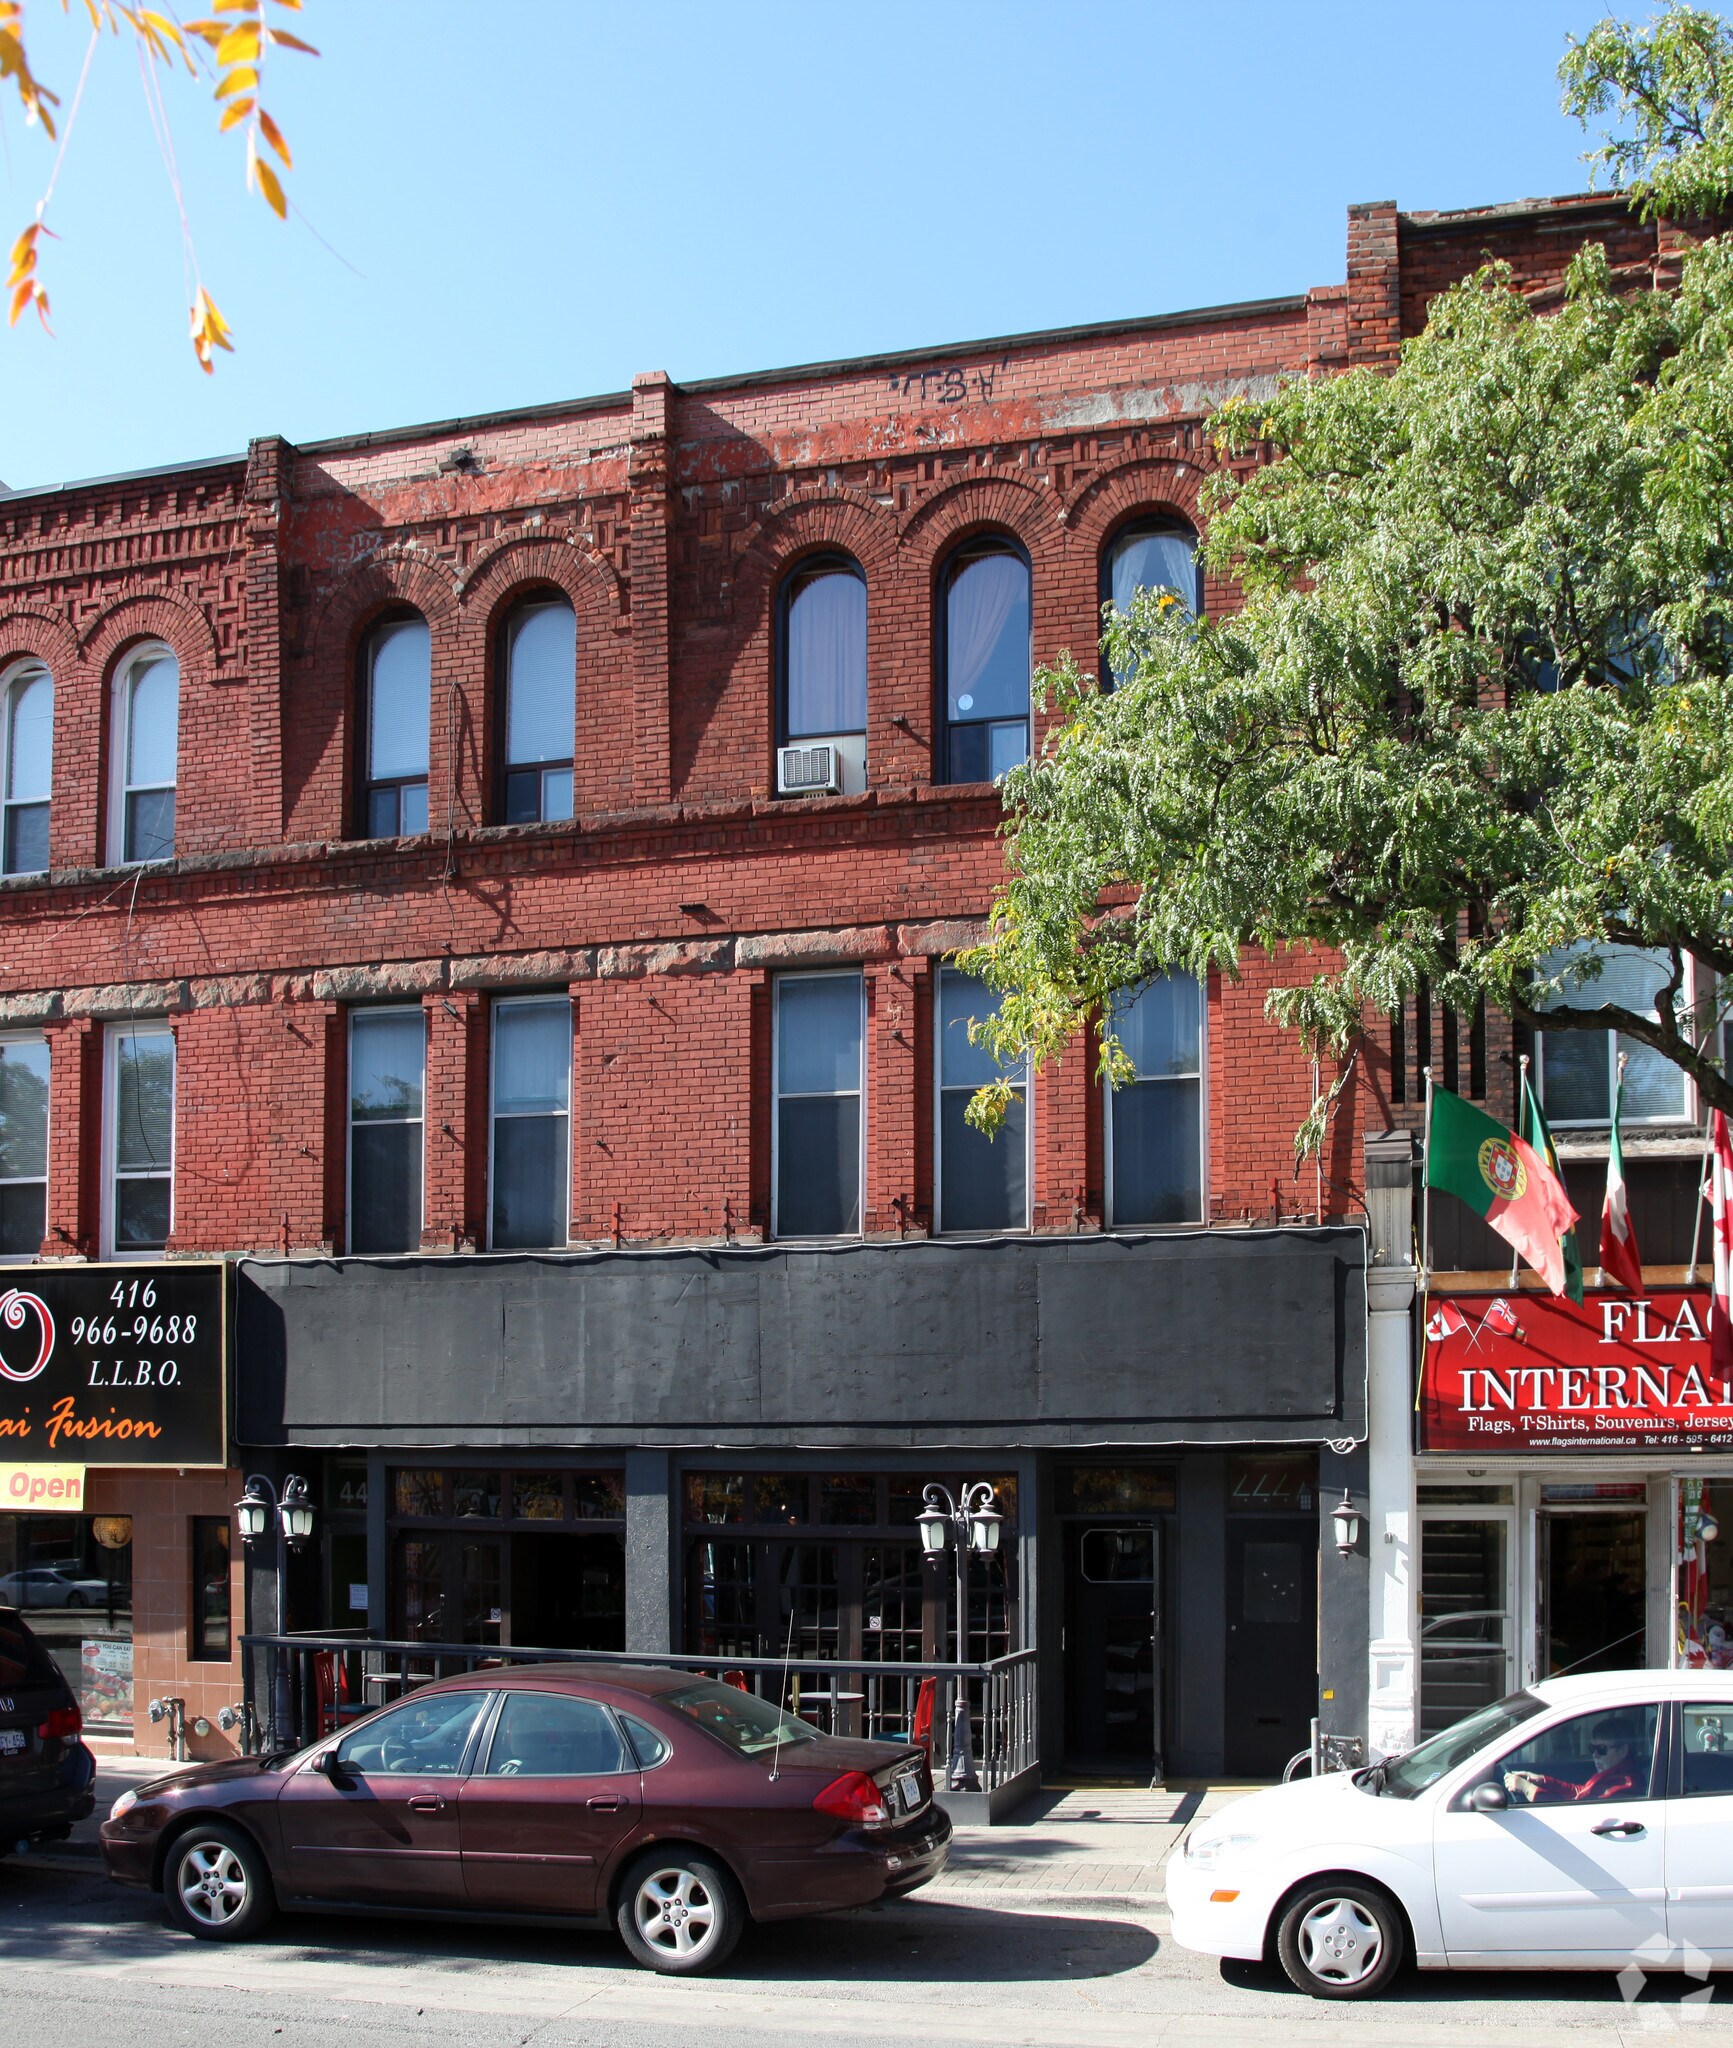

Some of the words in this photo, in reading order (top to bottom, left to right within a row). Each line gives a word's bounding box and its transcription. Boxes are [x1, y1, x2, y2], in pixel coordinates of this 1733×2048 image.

[109, 1279, 157, 1308] 416
[71, 1315, 197, 1345] 966-9688
[1598, 1300, 1712, 1344] FLA
[88, 1360, 181, 1386] L.L.B.O.
[45, 1396, 161, 1448] Fusion
[1468, 1416, 1515, 1434] Flags,
[1520, 1414, 1590, 1432] T-Shirts,
[1594, 1413, 1680, 1431] Souvenirs,
[1529, 1436, 1636, 1448] www.flagsinternational.ca
[1644, 1435, 1659, 1444] Tel:
[1661, 1435, 1678, 1444] 416
[1686, 1434, 1703, 1443] 595
[1710, 1434, 1733, 1443] 6412
[9, 1472, 81, 1503] Open
